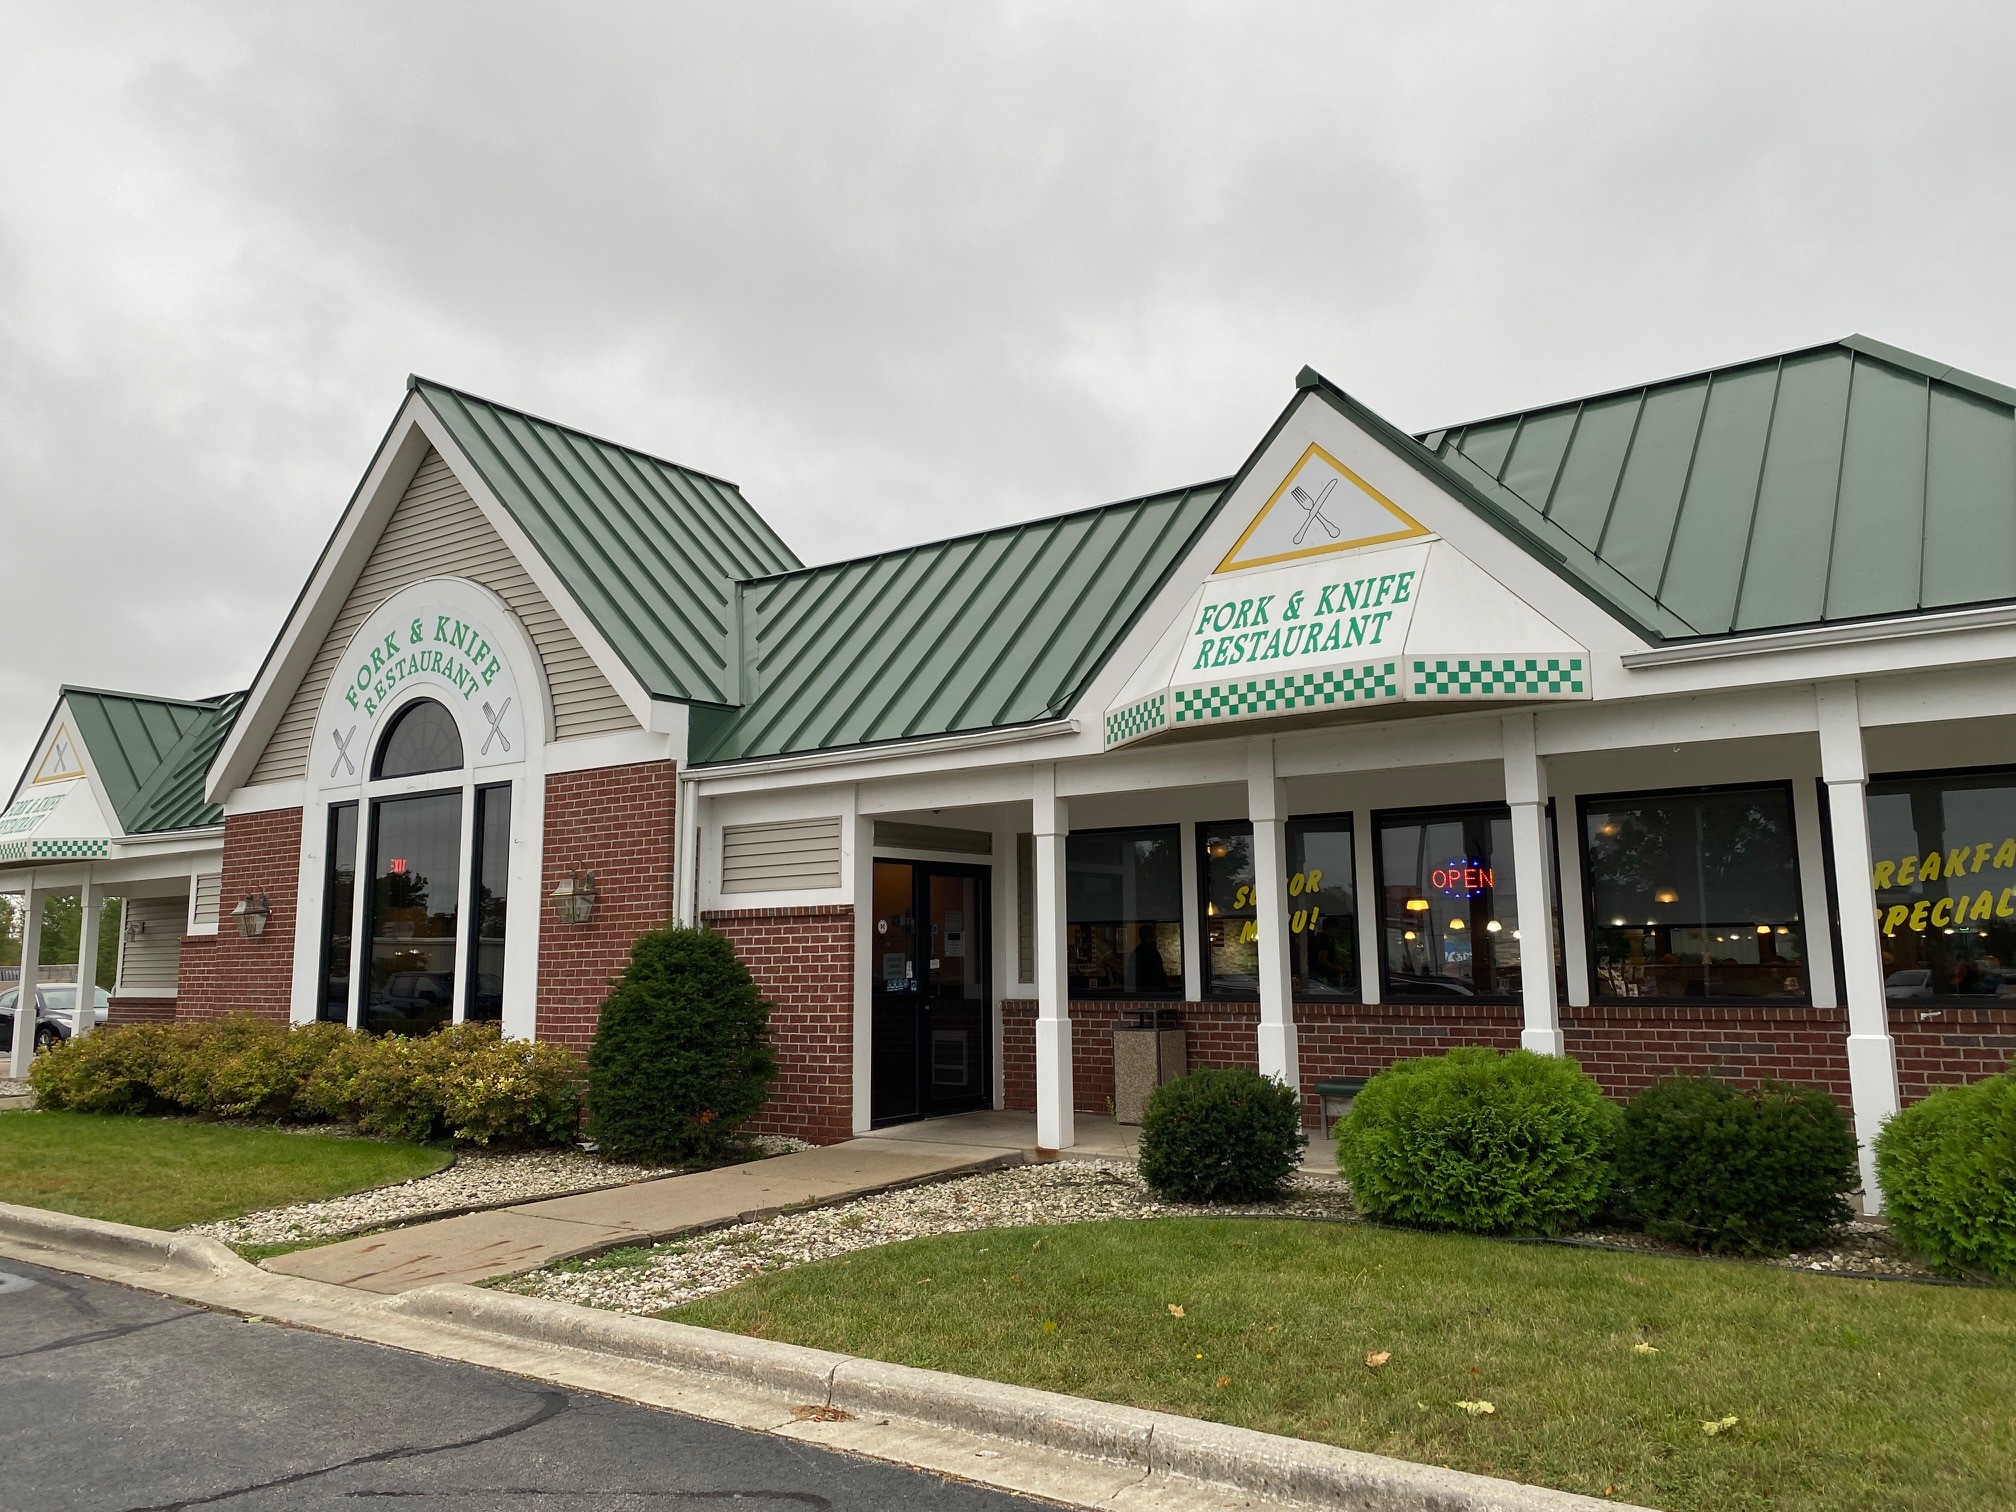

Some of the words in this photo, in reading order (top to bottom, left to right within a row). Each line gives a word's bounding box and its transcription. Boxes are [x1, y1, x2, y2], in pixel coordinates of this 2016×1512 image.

[1195, 594, 1276, 635] FORK
[1282, 589, 1306, 622] &
[1313, 570, 1416, 617] KNIFE
[345, 630, 400, 711] FORK
[409, 617, 424, 645] &
[433, 615, 501, 687] KNIFE
[1192, 611, 1393, 670] RESTAURANT
[363, 650, 480, 718] RESTAURANT
[1233, 869, 1323, 910] SOR
[1432, 868, 1494, 889] OPEN
[1873, 838, 2016, 891] REAKFA
[1240, 906, 1320, 944] MU!
[1876, 887, 2015, 935] PECIAL
